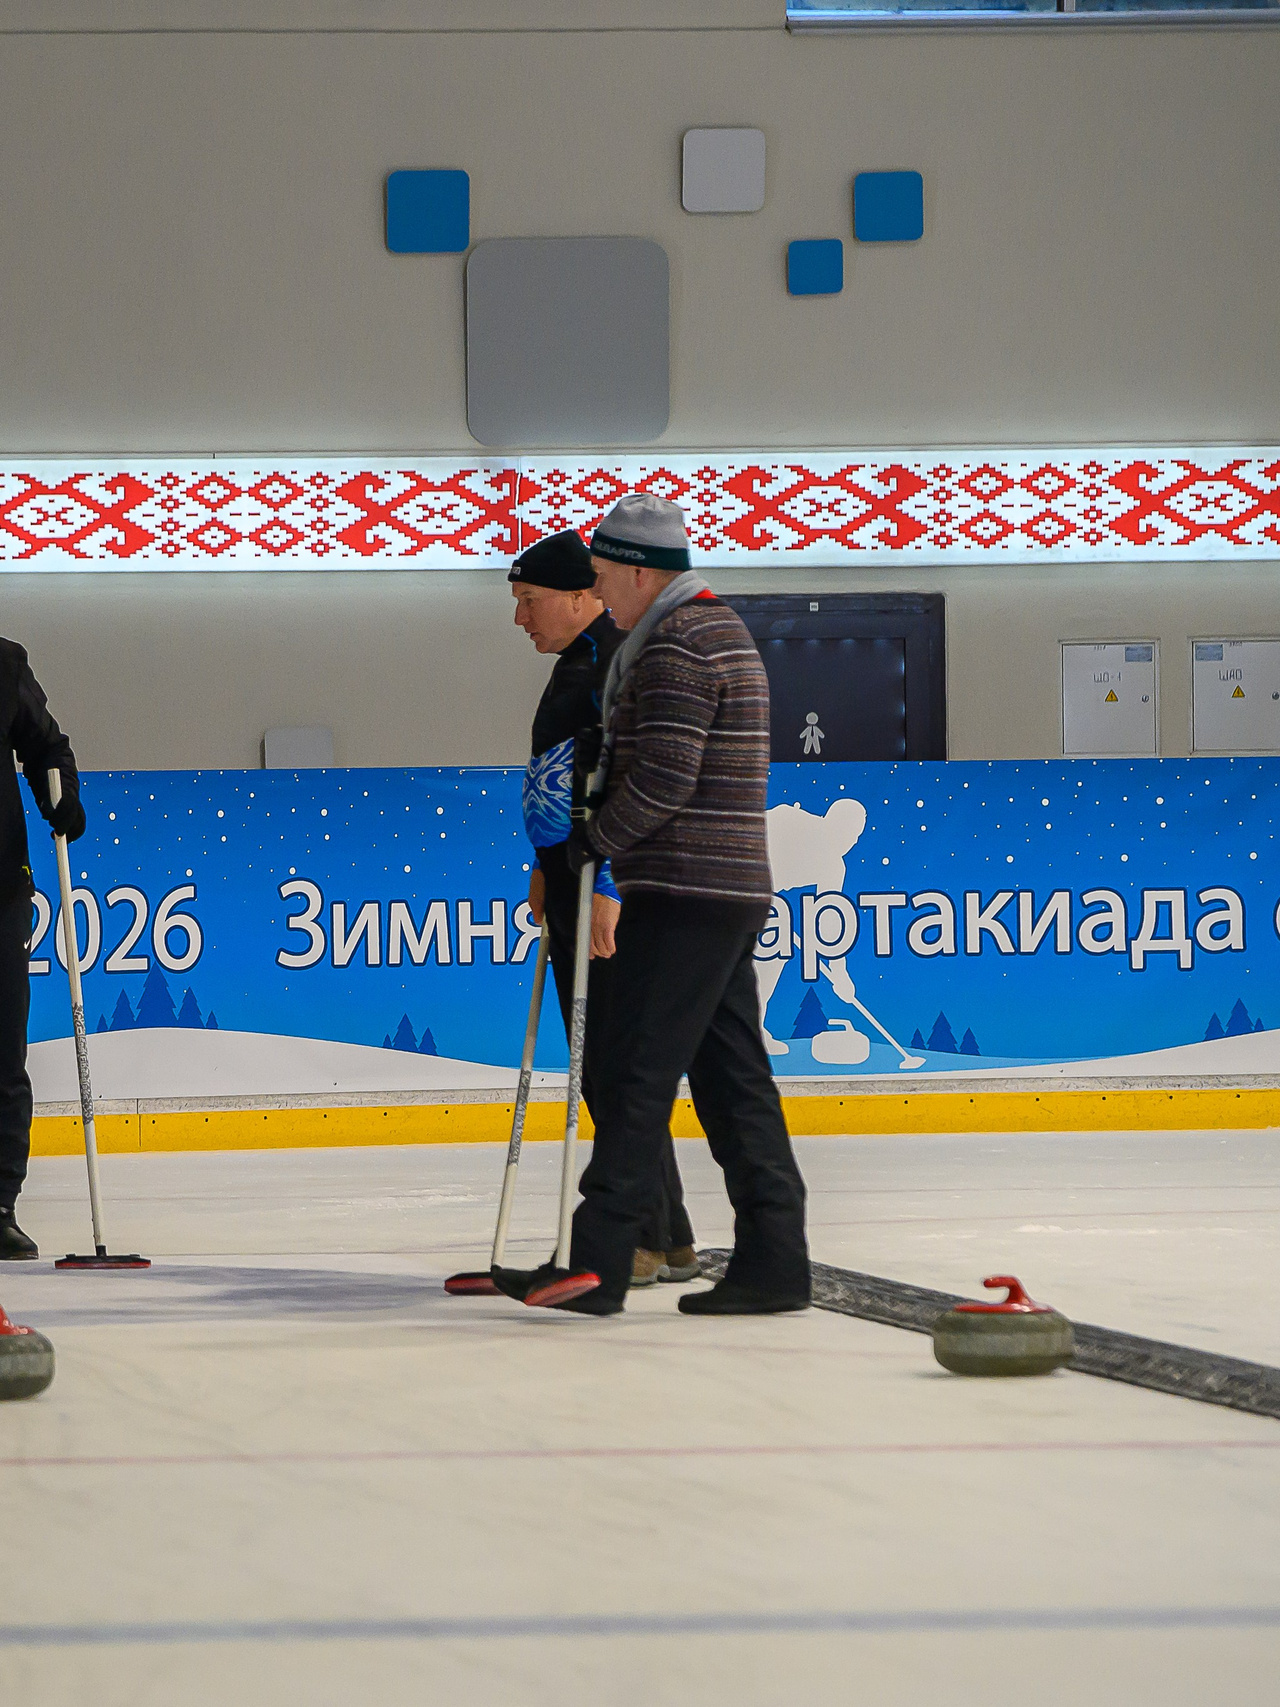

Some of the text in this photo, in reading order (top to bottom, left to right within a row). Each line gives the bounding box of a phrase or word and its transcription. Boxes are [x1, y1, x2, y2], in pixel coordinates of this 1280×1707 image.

[28, 884, 203, 974] 2026
[277, 879, 552, 967] Зимня
[752, 887, 1245, 980] артакиада
